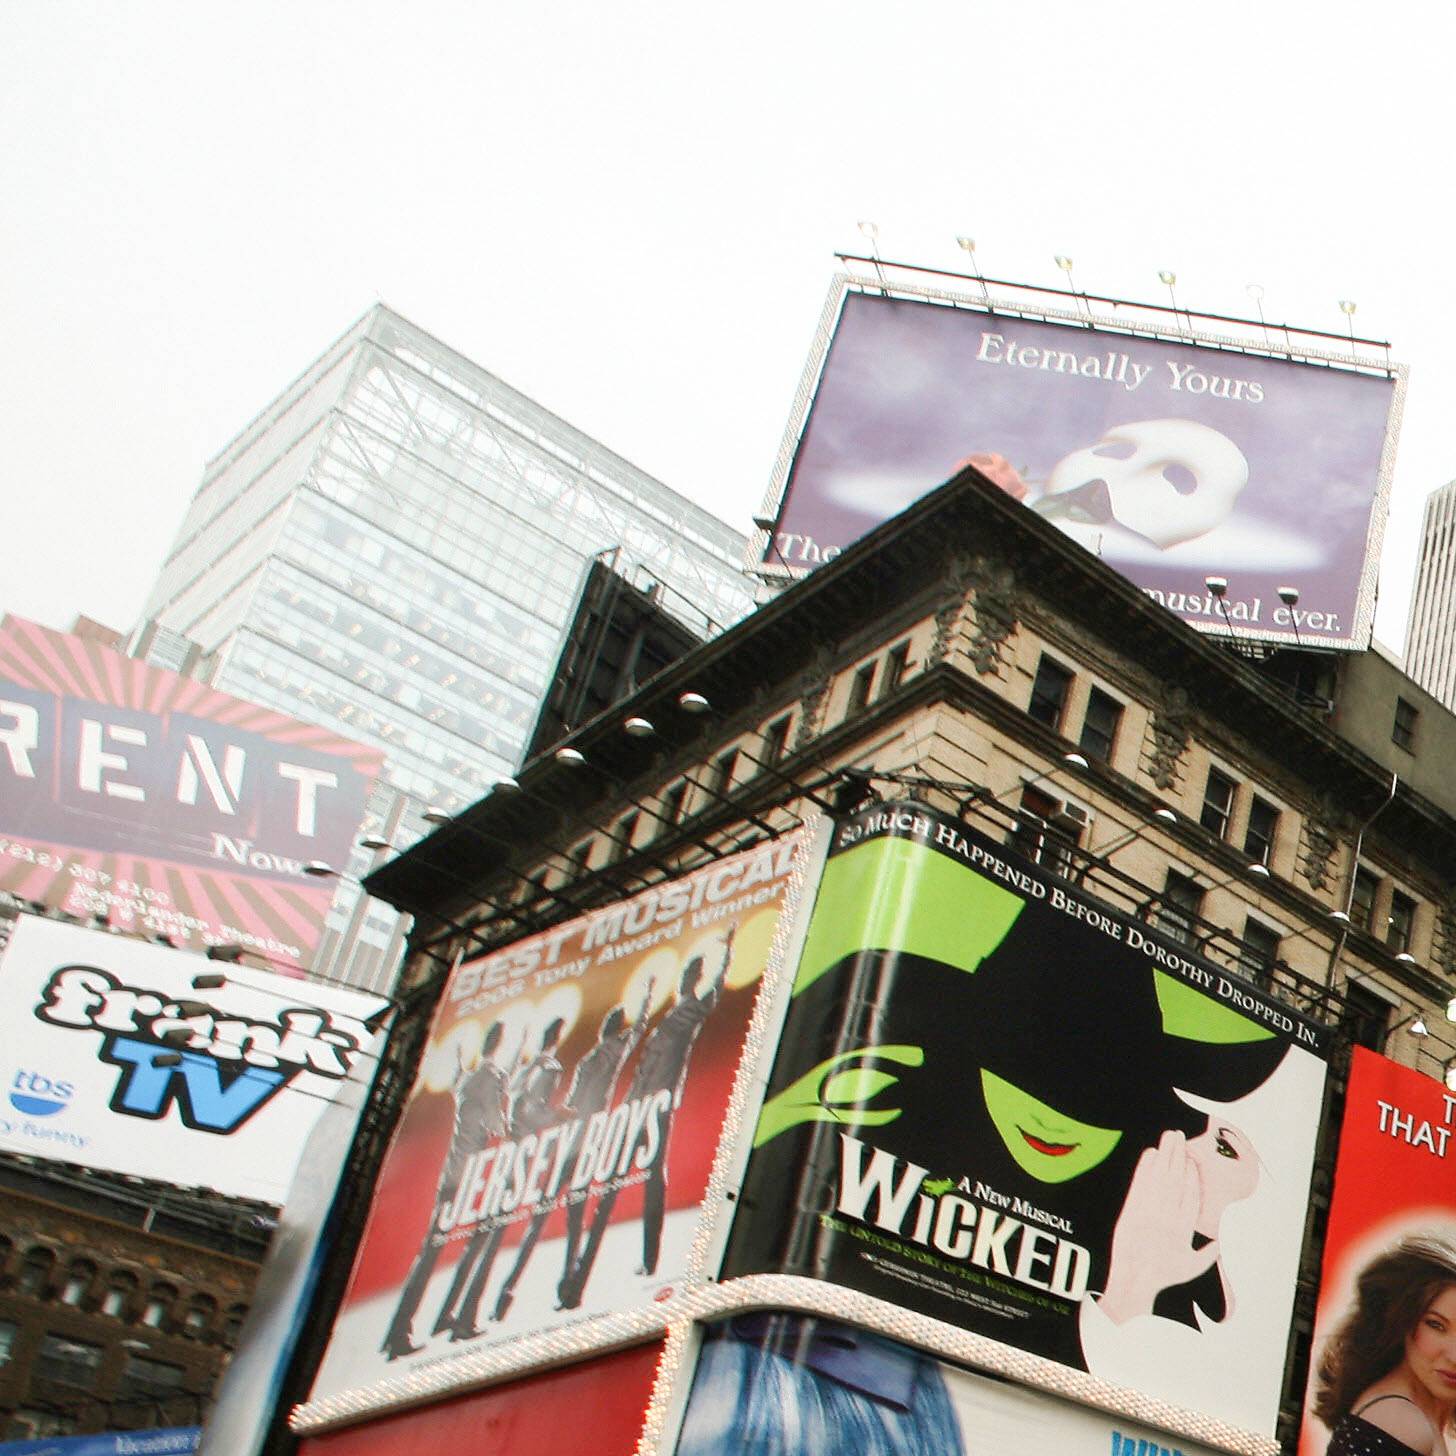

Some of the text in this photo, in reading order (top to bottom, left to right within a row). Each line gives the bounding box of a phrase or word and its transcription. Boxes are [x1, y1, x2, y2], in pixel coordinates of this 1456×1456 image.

[975, 332, 1266, 404] Eternally Yours
[1273, 602, 1342, 633] ever.
[581, 841, 799, 951] MUSICAL
[451, 927, 579, 1001] BEST
[535, 921, 683, 989] Tony Award
[935, 822, 1320, 1048] HAPPENED BEFORE DOROTHY DROPPED IN.
[14, 1068, 75, 1100] tbs
[105, 1034, 290, 1132] TV
[438, 1119, 583, 1233] JERSEY
[571, 1089, 672, 1190] BOYS
[1377, 1100, 1451, 1159] THAT
